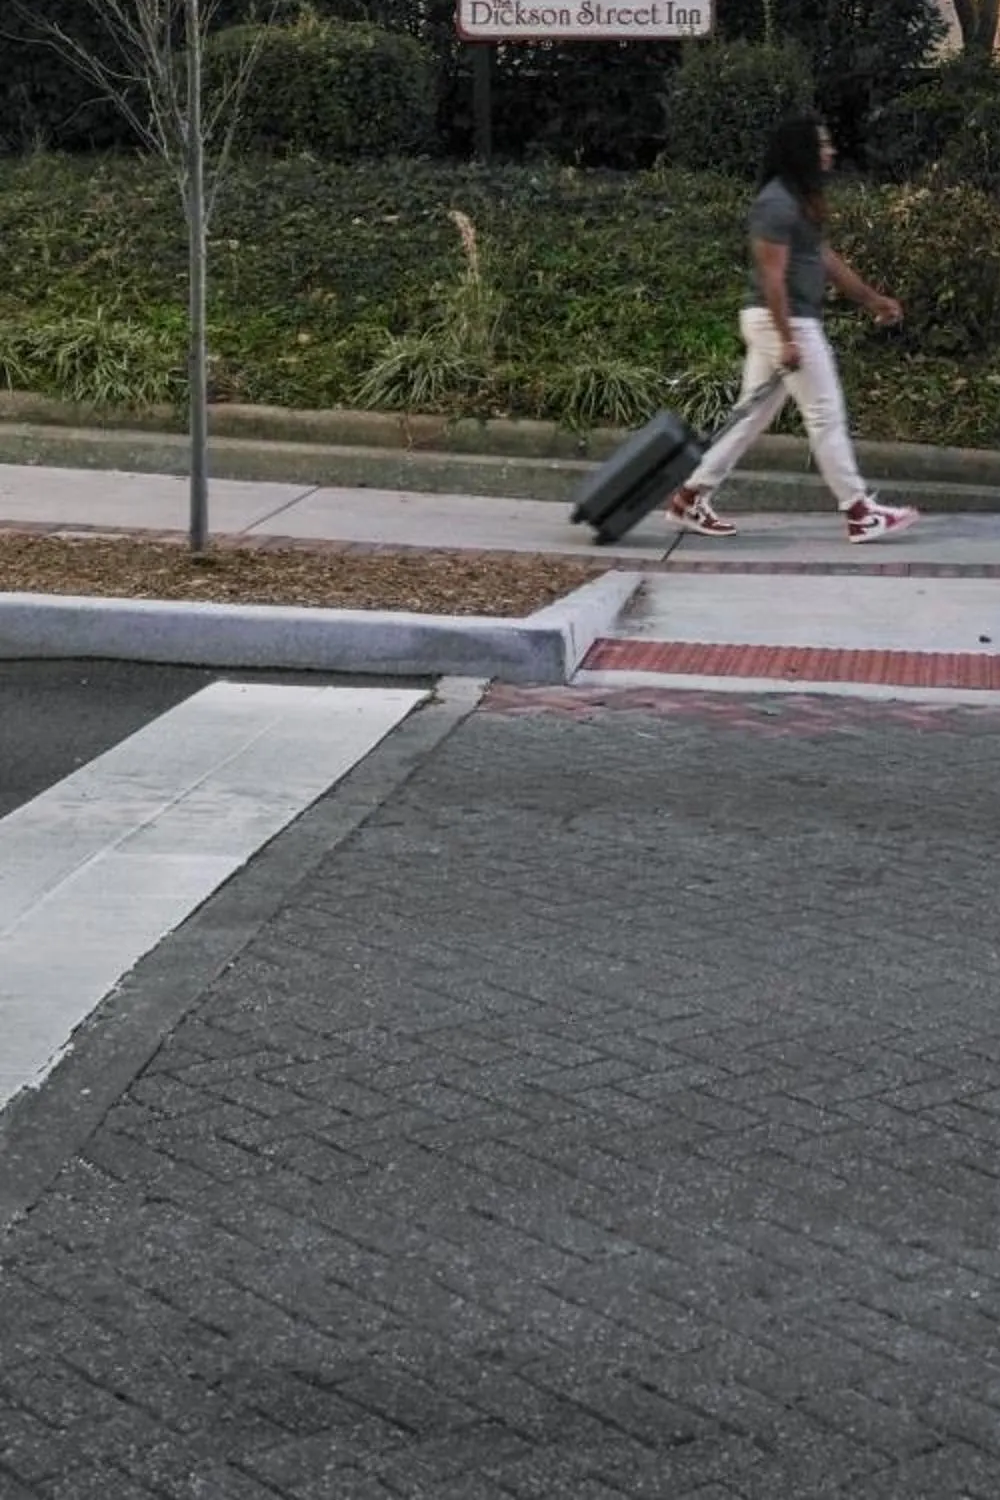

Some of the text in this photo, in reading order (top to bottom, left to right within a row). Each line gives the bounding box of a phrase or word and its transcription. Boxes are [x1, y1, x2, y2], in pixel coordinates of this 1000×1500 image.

[470, 0, 701, 26] Dickson Street Inn
